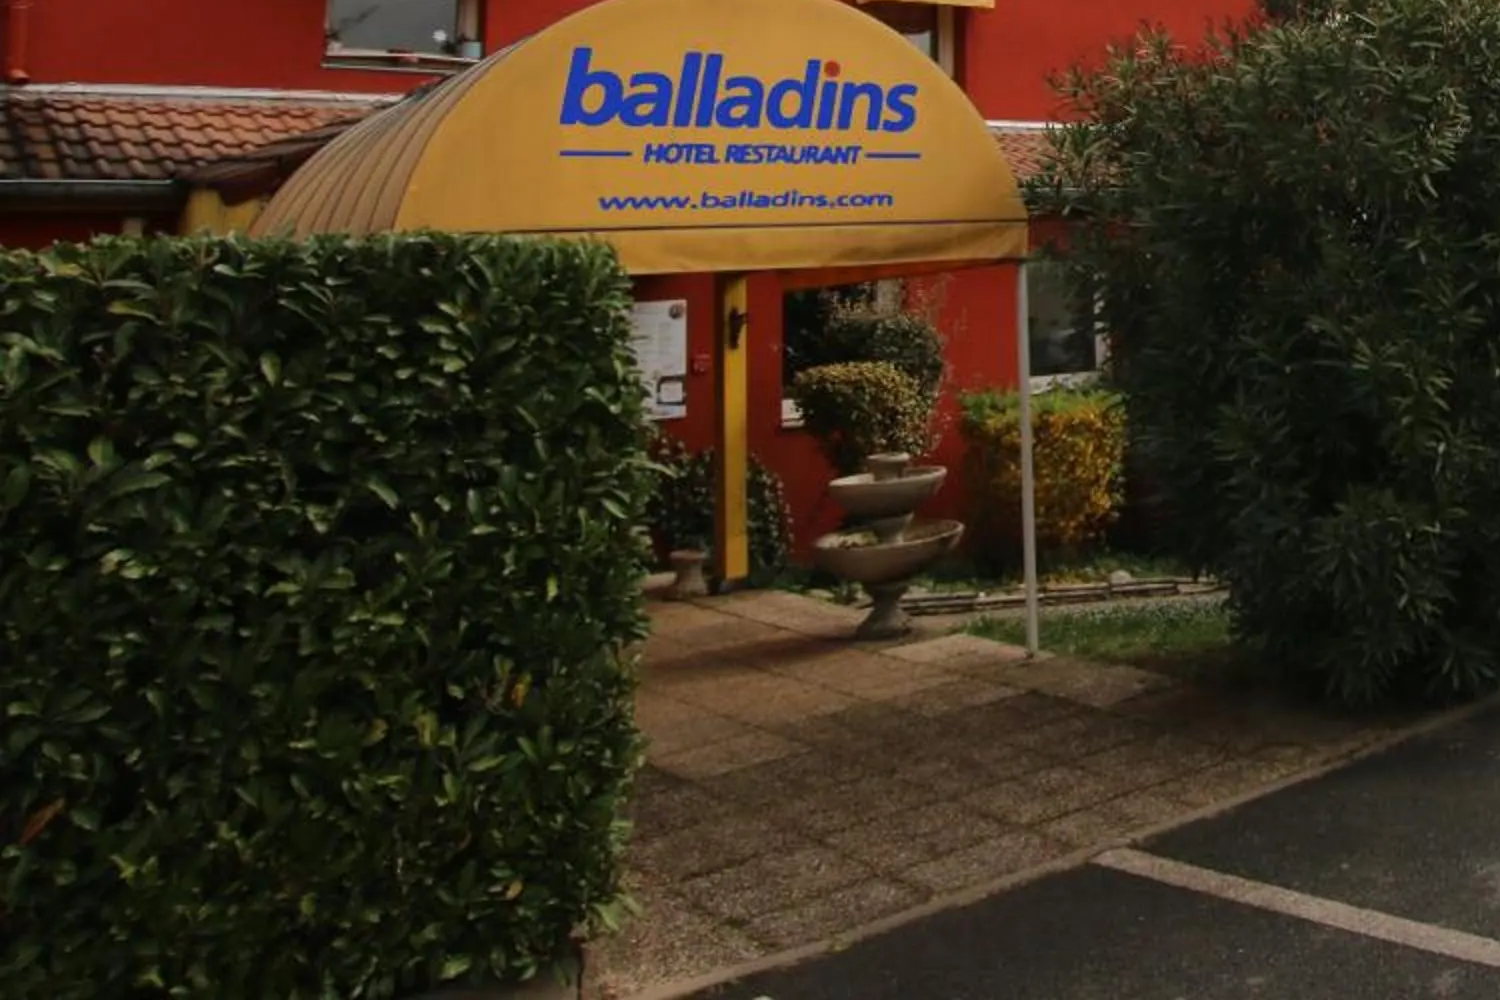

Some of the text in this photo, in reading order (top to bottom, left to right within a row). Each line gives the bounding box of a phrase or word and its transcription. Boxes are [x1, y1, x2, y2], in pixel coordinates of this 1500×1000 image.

[559, 47, 919, 132] balladins
[643, 143, 862, 164] HOTEL RESTAURANT
[597, 188, 894, 211] www.balladins.com
